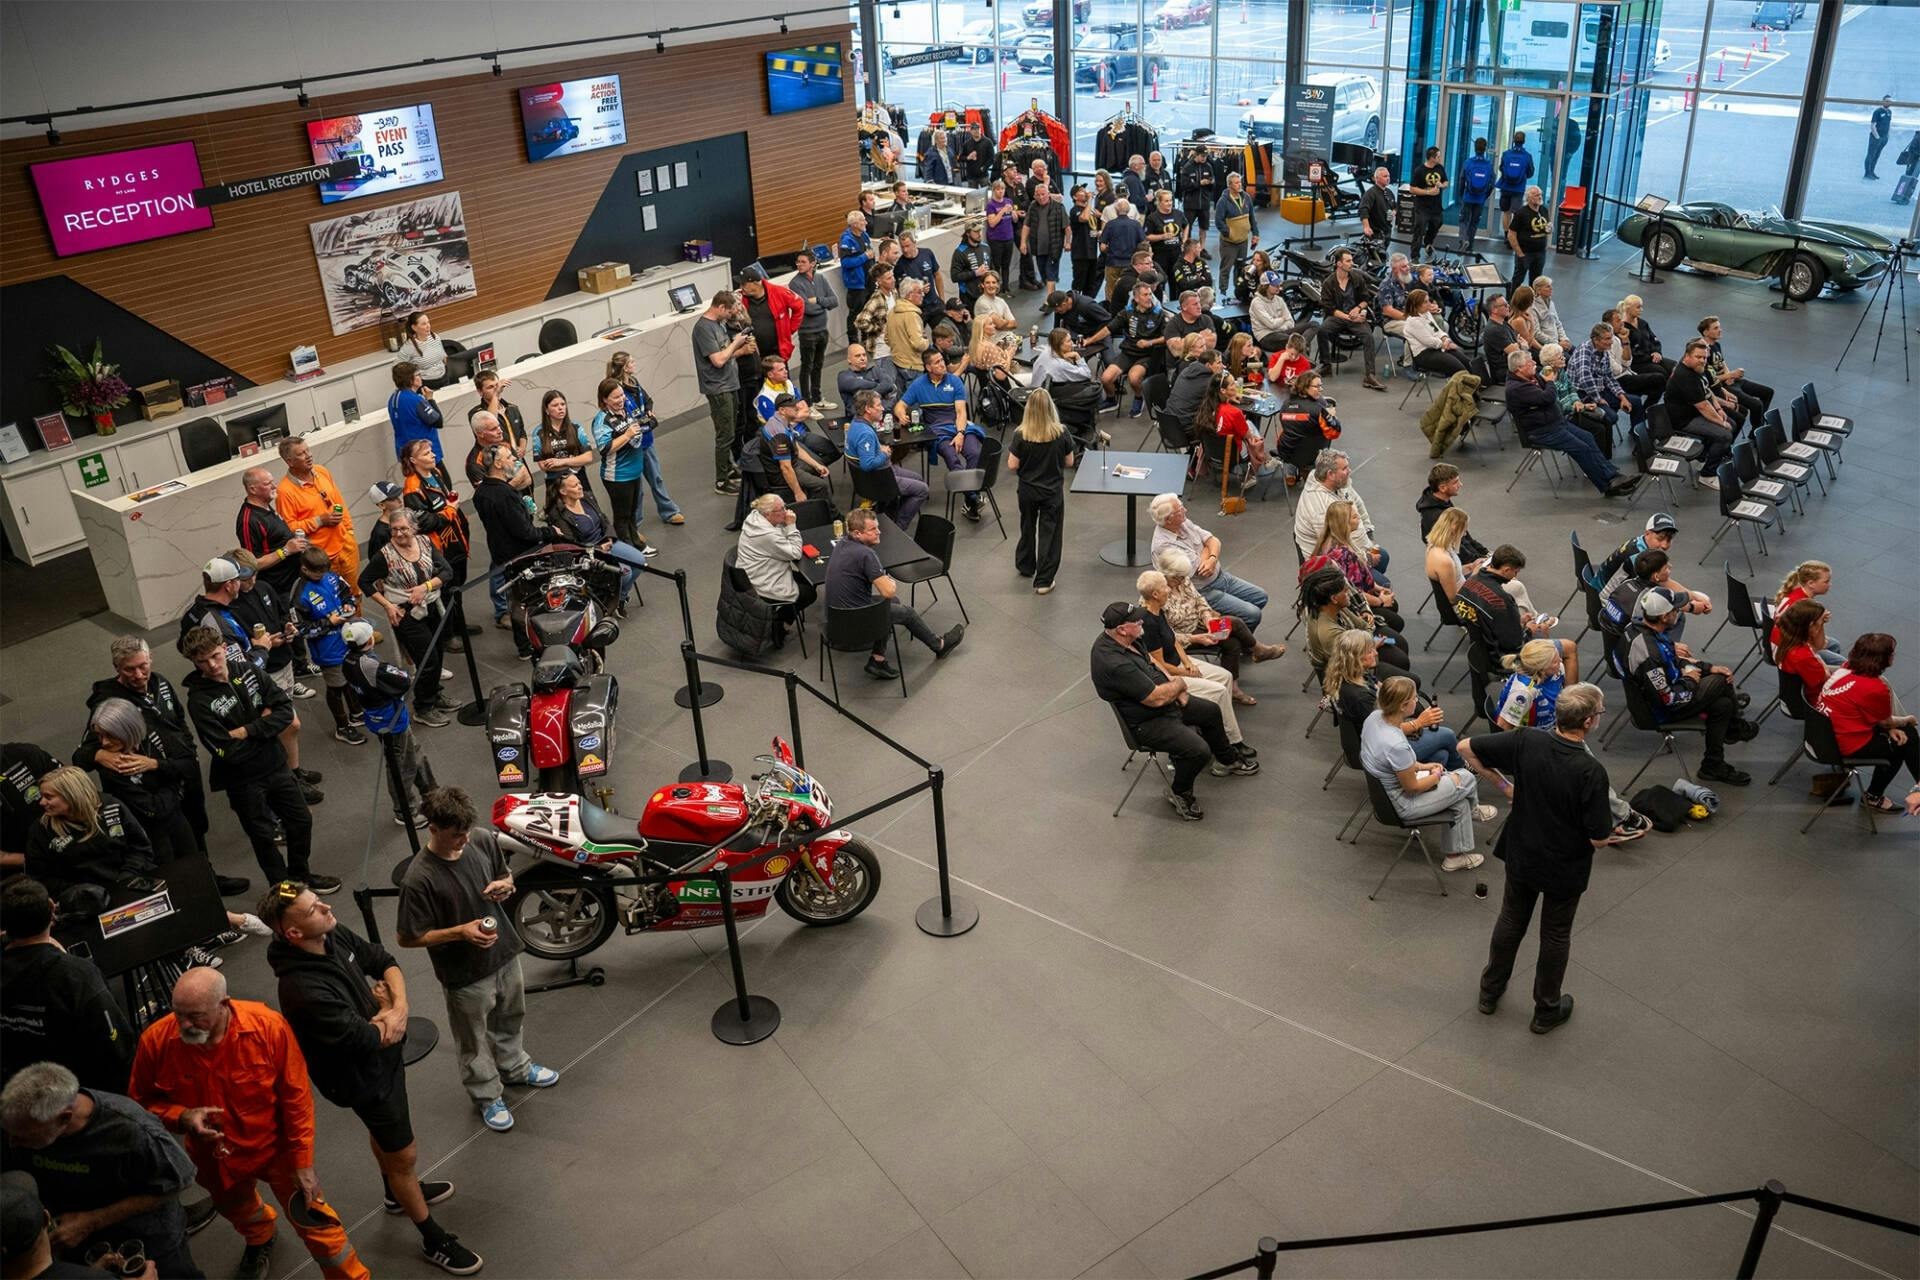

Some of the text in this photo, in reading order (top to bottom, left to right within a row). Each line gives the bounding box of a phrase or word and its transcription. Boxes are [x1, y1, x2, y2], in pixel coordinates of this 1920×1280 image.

[590, 90, 617, 100] ACTION
[601, 96, 618, 105] FREE
[597, 104, 619, 113] ENTRY
[375, 127, 408, 144] EVENT
[378, 142, 405, 158] PASS
[84, 168, 160, 190] RYDGES
[228, 167, 331, 198] HOTEL RECEPTION
[64, 192, 195, 232] RECEPTION
[578, 720, 604, 731] Medallia
[492, 733, 517, 743] Medallia
